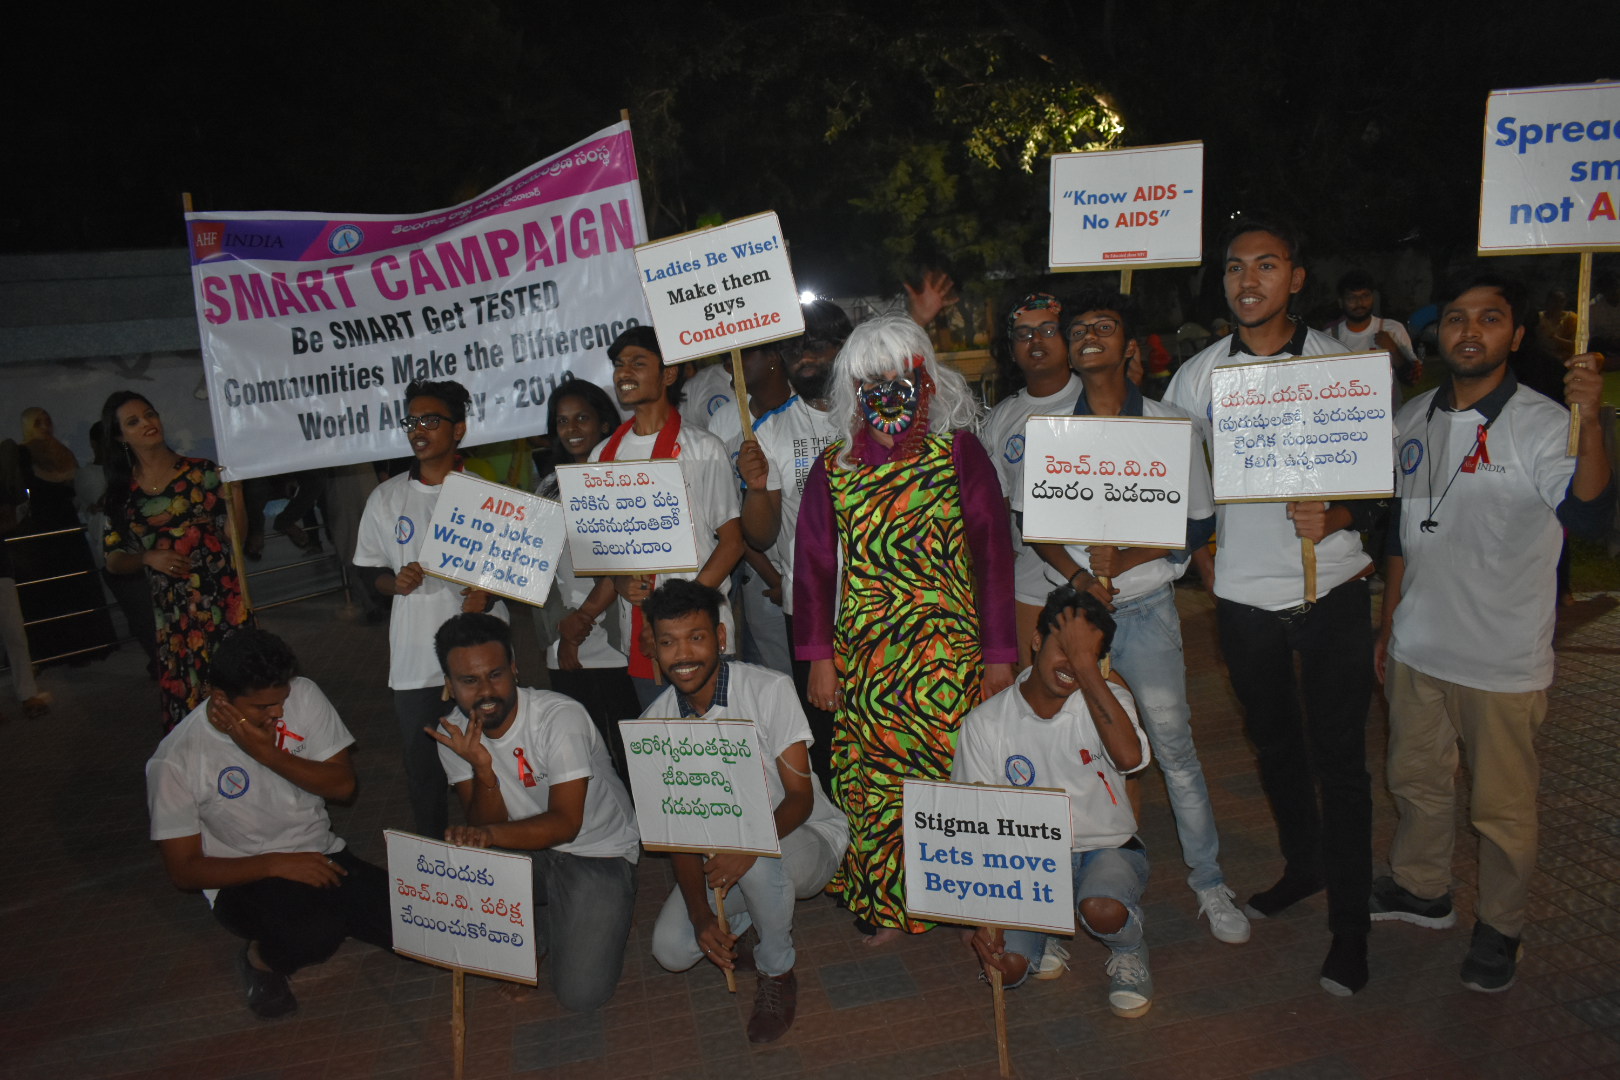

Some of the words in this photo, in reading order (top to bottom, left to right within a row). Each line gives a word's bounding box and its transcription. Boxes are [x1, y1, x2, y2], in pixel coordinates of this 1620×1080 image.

[1495, 116, 1620, 154] Sprea
[1133, 184, 1178, 202] AIDS
[1083, 214, 1109, 229] No
[1509, 197, 1574, 225] not
[196, 231, 218, 247] AHF
[224, 233, 285, 248] INDIA
[202, 264, 357, 325] SMART
[371, 199, 635, 301] CAMPAIGN
[644, 259, 702, 283] Ladies
[705, 252, 728, 267] Be
[731, 235, 779, 259] Wise!
[667, 283, 717, 306] Make
[722, 269, 772, 292] them
[291, 326, 324, 355] Be
[329, 310, 415, 350] SMART
[422, 301, 466, 334] Get
[470, 280, 559, 325] TESTED
[703, 296, 746, 321] guys
[679, 312, 781, 346] Condomize
[224, 363, 385, 408] Communities
[391, 349, 457, 385] Make
[464, 341, 504, 372] the
[298, 405, 370, 441] World
[793, 438, 808, 448] BE
[794, 447, 809, 457] BE
[795, 457, 809, 468] BE
[795, 467, 809, 478] BE
[1477, 463, 1506, 474] INDIA
[570, 495, 610, 511] సోకిన
[616, 496, 647, 510] వారి
[652, 491, 680, 515] పట్ల
[1032, 480, 1094, 501] దూరం
[1104, 483, 1181, 504] పెడదాం
[450, 507, 466, 525] is
[471, 518, 495, 534] no
[481, 496, 528, 521] AIDS
[575, 513, 680, 535] సహానుభూతితో
[434, 523, 483, 556] Wrap
[489, 540, 550, 572] before
[592, 539, 672, 556] మెలుగుదాం
[439, 552, 477, 573] you
[630, 735, 752, 764] ఆరోగ్యవంతమైన
[662, 766, 733, 795] జీవితాన్ని
[661, 797, 743, 819] గడుపుదాం
[914, 811, 990, 837] Stigma
[996, 818, 1062, 841] Hurts
[416, 854, 495, 887] మీరెందుకు
[919, 842, 974, 866] Lets
[983, 853, 1057, 873] move
[924, 872, 1023, 900] Beyond
[1032, 881, 1055, 903] it
[400, 905, 524, 947] చేయించుకోవాలి
[480, 897, 524, 927] పరీక్ష
